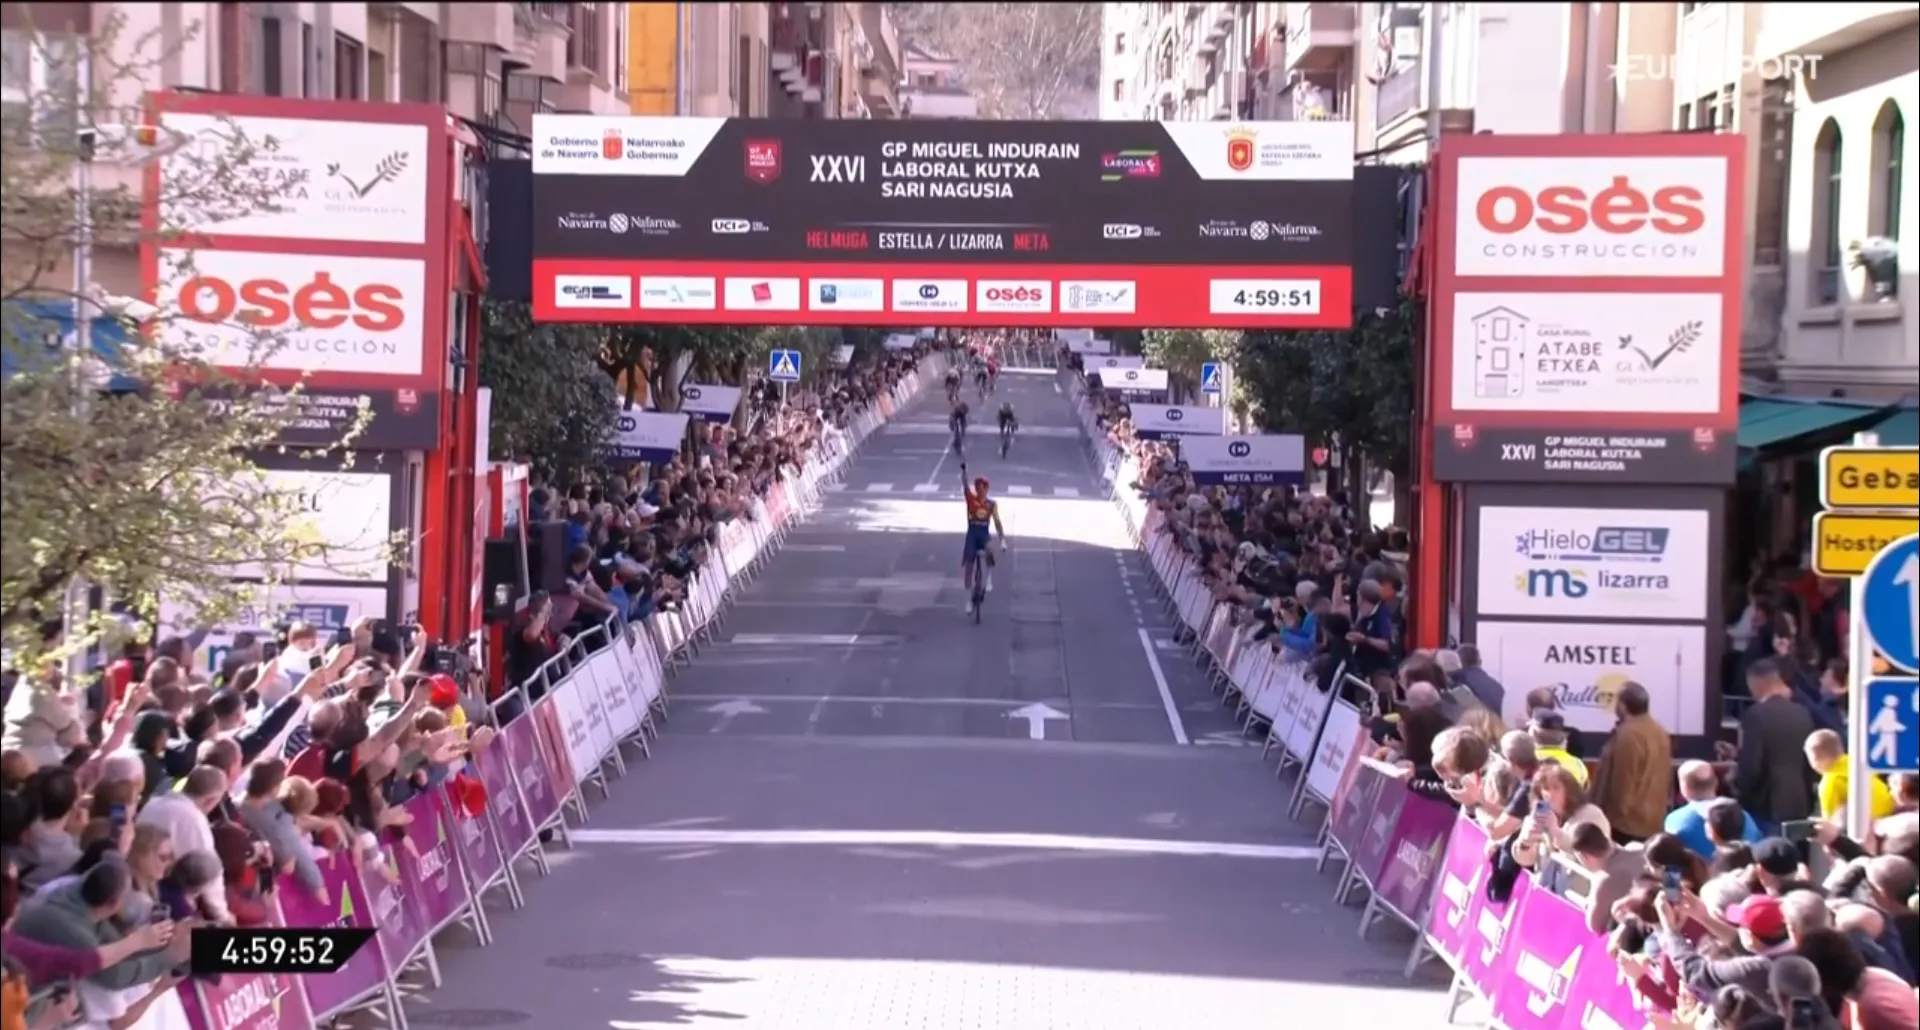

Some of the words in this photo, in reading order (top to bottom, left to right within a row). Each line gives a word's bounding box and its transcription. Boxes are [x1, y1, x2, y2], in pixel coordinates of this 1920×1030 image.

[549, 137, 599, 147] Gobierno
[541, 149, 555, 158] de
[557, 149, 599, 159] Navarra
[881, 142, 908, 158] GP
[912, 142, 983, 159] MIGUEL
[988, 143, 1080, 159] INDURAIN
[810, 155, 865, 182] XXVI
[881, 162, 970, 178] LABORAL
[975, 162, 1040, 178] KUTXA
[881, 181, 925, 197] SARI
[929, 182, 1014, 198] NAGUSIA
[558, 216, 607, 229] Navarra
[714, 220, 736, 231] UCI
[1106, 227, 1128, 237] UCI
[1199, 224, 1248, 238] Navarra
[807, 231, 869, 249] HELMUGA
[878, 232, 934, 249] ESTELLA
[937, 233, 946, 249] /
[950, 233, 1004, 250] LIZARRA
[1014, 233, 1049, 250] META
[1483, 242, 1698, 259] CONSTRUCCIÓN
[1233, 289, 1311, 306] 4:59:51
[1537, 341, 1603, 356] ATABE
[1537, 358, 1601, 373] ETXEA
[1544, 436, 1561, 447] GP
[1563, 437, 1606, 448] MIGUEL
[1609, 437, 1667, 448] INDURAIN
[1501, 444, 1536, 460] XXVI
[1544, 447, 1599, 459] LABORAL
[1600, 448, 1642, 460] KUTXA
[1544, 459, 1571, 471] SARI
[1573, 460, 1625, 471] NAGUSIA
[1223, 473, 1252, 482] META
[1597, 530, 1661, 551] GEL
[1825, 533, 1898, 552] Hosta
[1598, 570, 1669, 590] lizarra
[1543, 644, 1636, 665] AMSTEL
